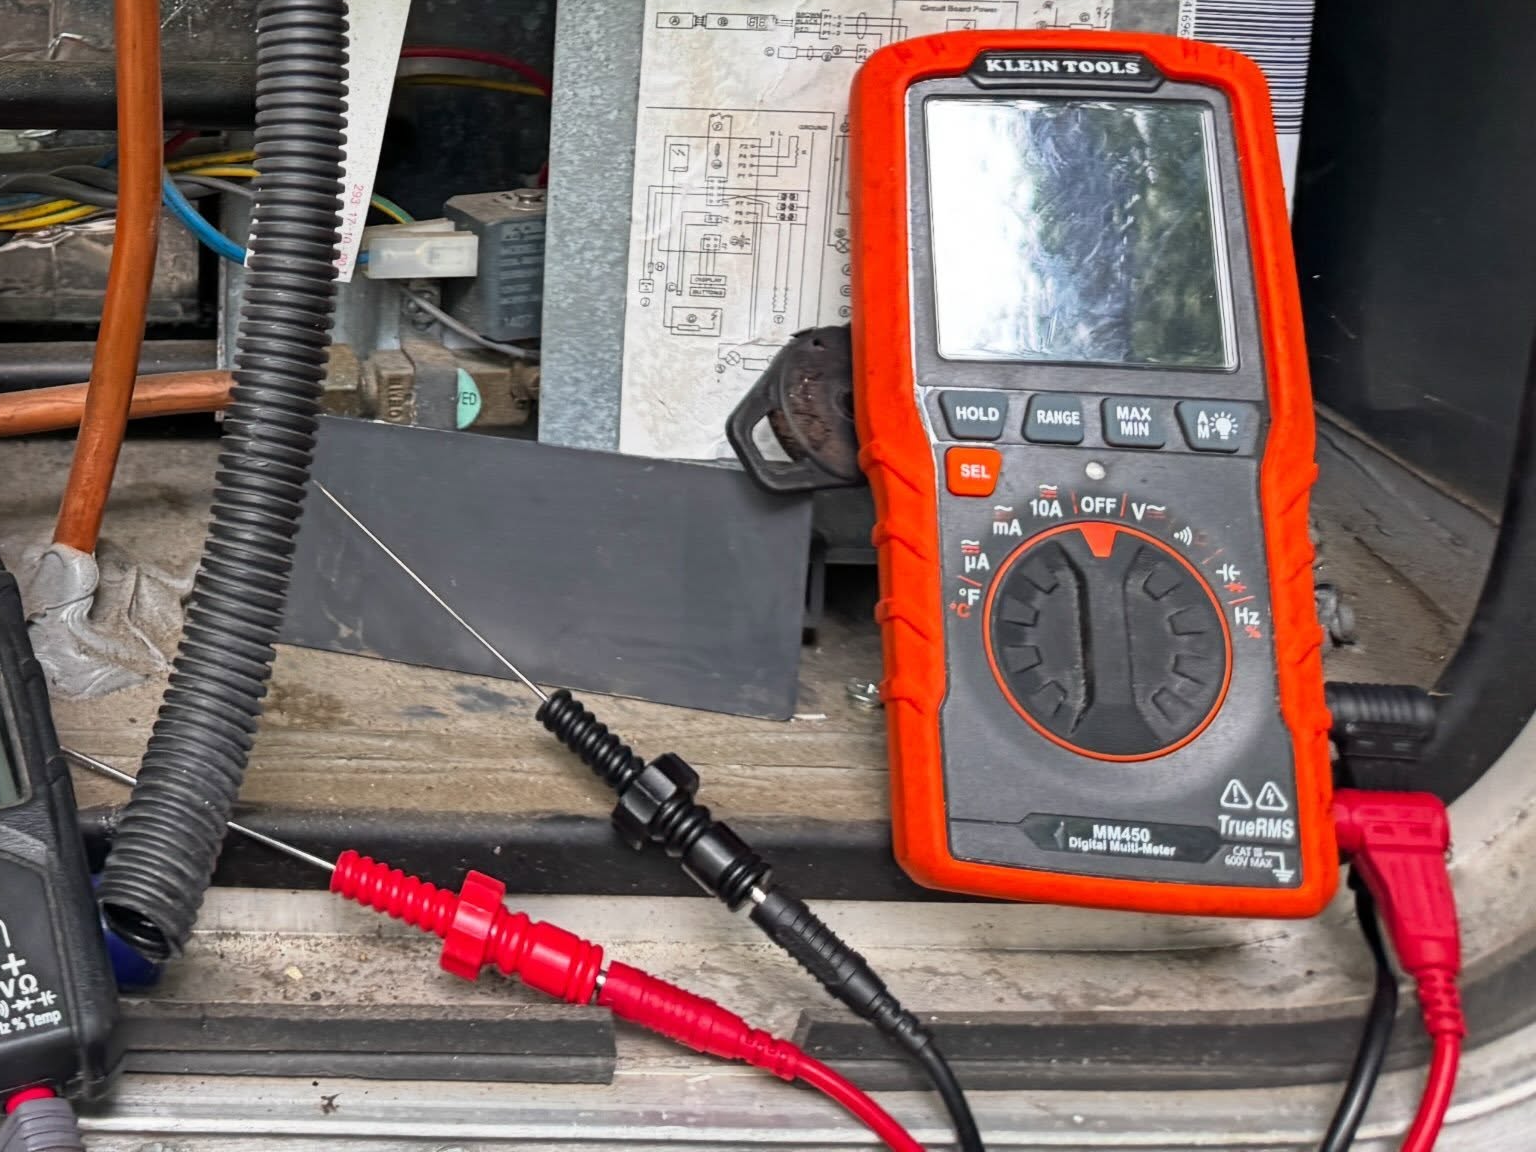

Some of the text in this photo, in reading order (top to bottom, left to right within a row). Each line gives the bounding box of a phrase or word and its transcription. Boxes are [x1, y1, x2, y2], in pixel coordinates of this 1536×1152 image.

[985, 59, 1141, 74] KLEIN TOOLS
[955, 406, 999, 421] HOLD
[1037, 409, 1080, 425] RANGE
[1116, 406, 1152, 421] MAX
[1120, 421, 1149, 437] MIN
[960, 464, 991, 479] SEL
[1030, 500, 1063, 518] 10A
[1080, 496, 1117, 515] OFF
[993, 519, 1023, 536] mA
[1234, 606, 1260, 626] Hz
[1092, 824, 1150, 842] MM450
[1218, 815, 1295, 839] TrueRMS
[1068, 836, 1176, 857] Digital Multi-Meter
[1232, 846, 1252, 857] CAT
[1225, 855, 1273, 868] 600V MAX
[25, 1009, 62, 1028] Temp
